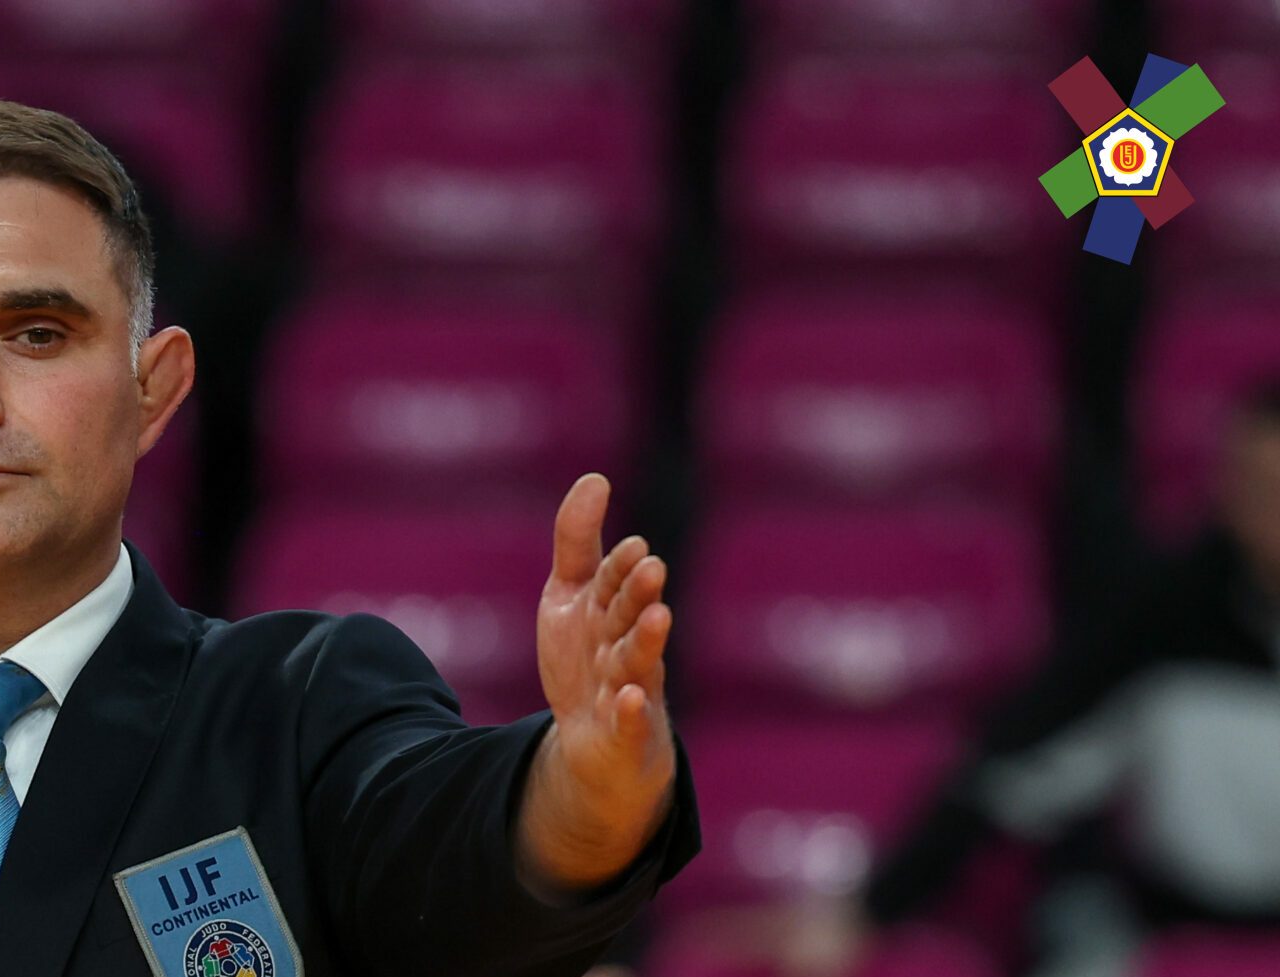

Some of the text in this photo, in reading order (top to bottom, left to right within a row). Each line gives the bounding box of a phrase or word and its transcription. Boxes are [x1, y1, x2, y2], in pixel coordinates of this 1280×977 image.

[158, 857, 222, 911] IJF
[151, 888, 259, 936] CONTINENTAL
[200, 922, 228, 938] JUDO
